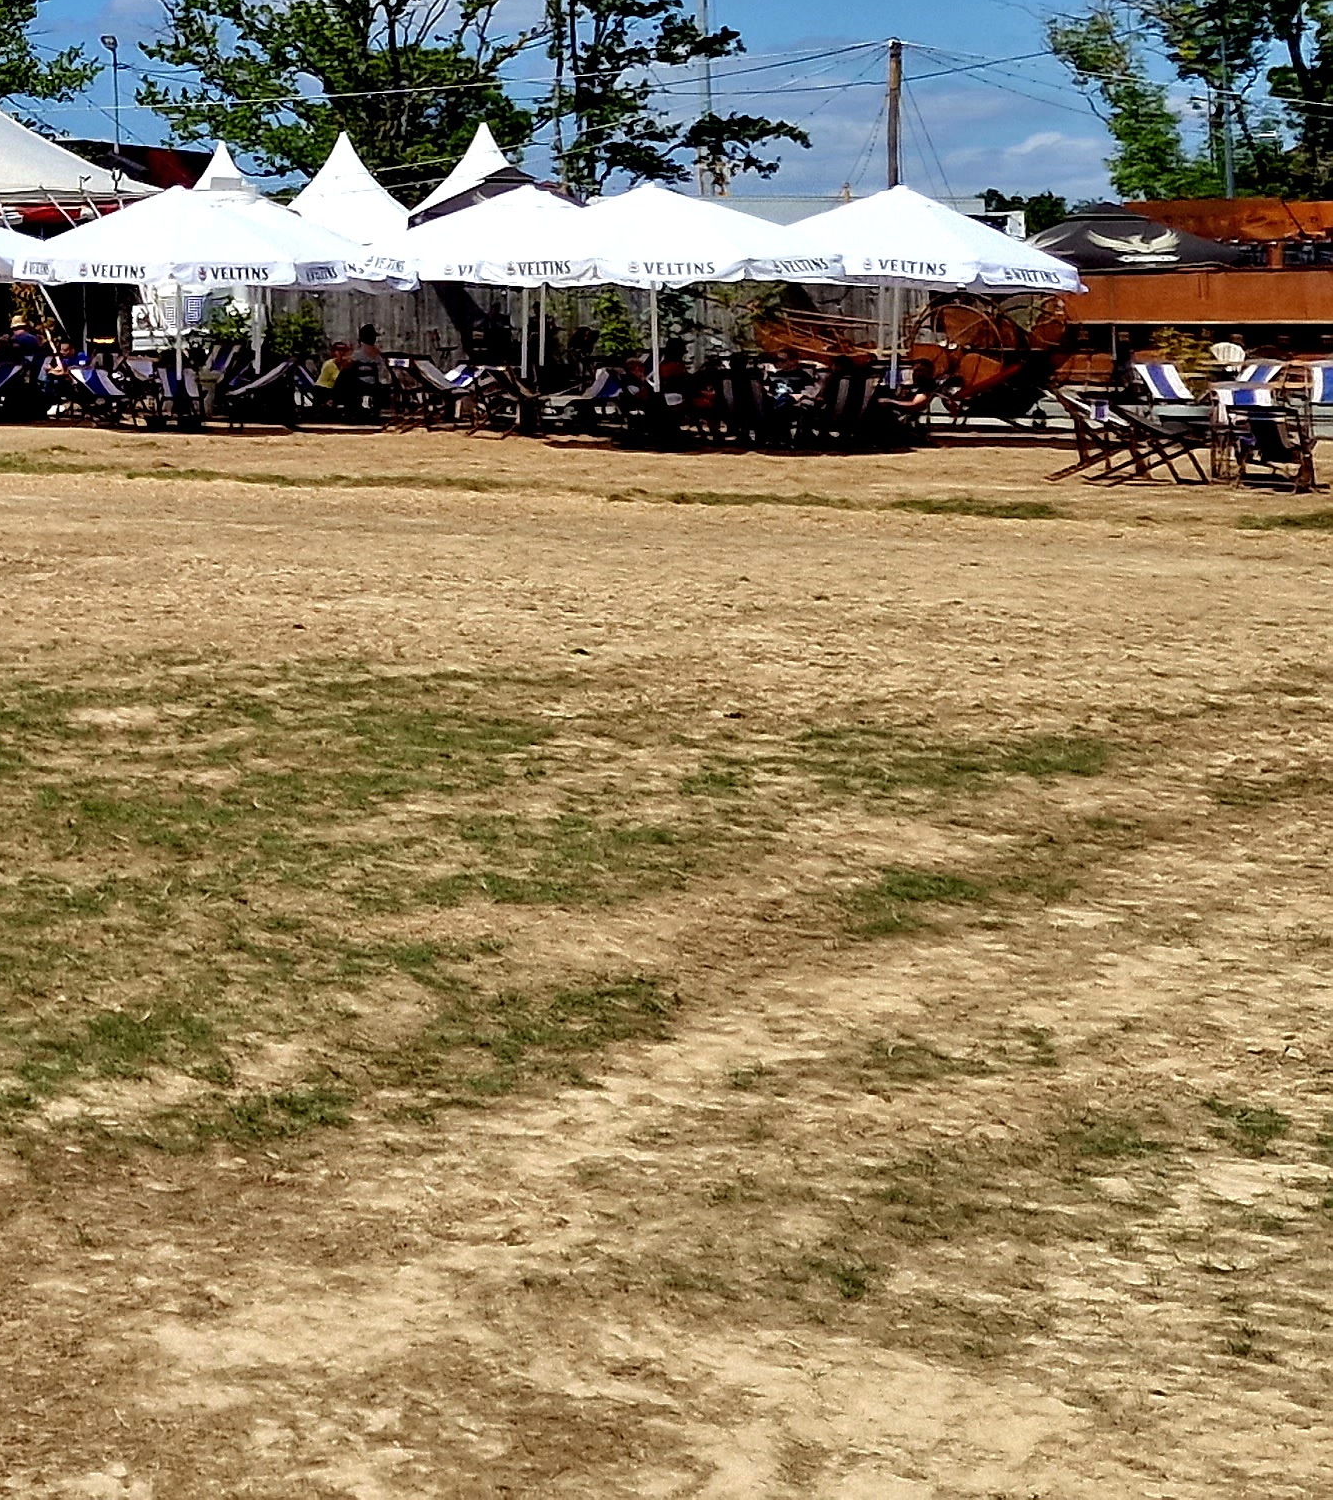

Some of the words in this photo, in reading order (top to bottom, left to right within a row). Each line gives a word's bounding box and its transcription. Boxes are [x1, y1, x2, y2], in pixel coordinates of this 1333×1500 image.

[91, 264, 146, 279] VELTINS
[210, 266, 269, 281] VELTINS
[516, 260, 571, 276] VELTINS
[643, 261, 715, 276] VELTINS
[878, 258, 947, 276] VELTINS
